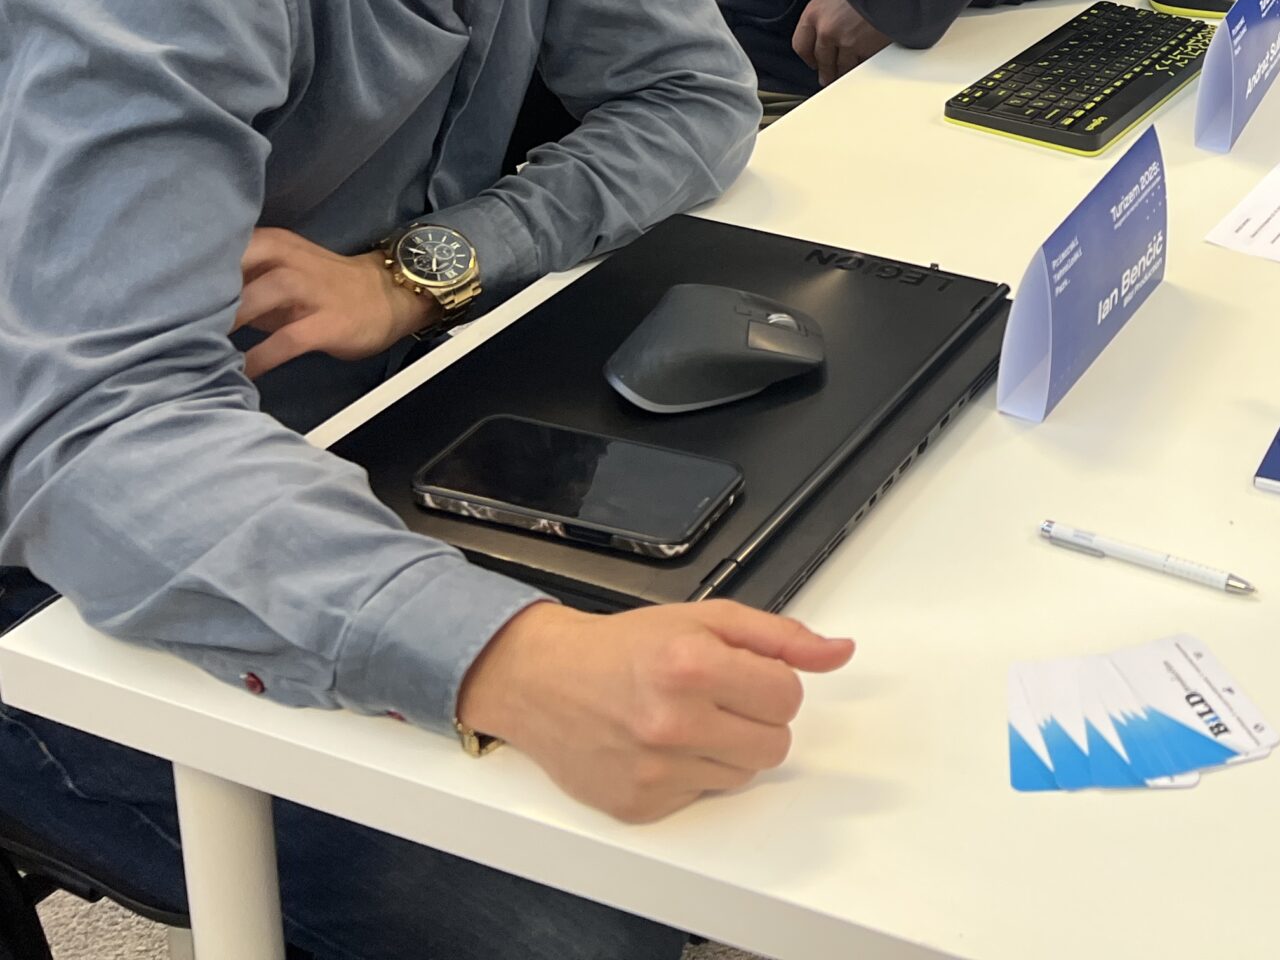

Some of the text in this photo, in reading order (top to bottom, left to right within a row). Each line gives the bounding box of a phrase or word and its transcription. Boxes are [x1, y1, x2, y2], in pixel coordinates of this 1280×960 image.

[1110, 185, 1140, 223] Turizem
[1140, 161, 1160, 191] 2025:
[804, 248, 956, 292] LEGION
[1097, 286, 1119, 326] Ian
